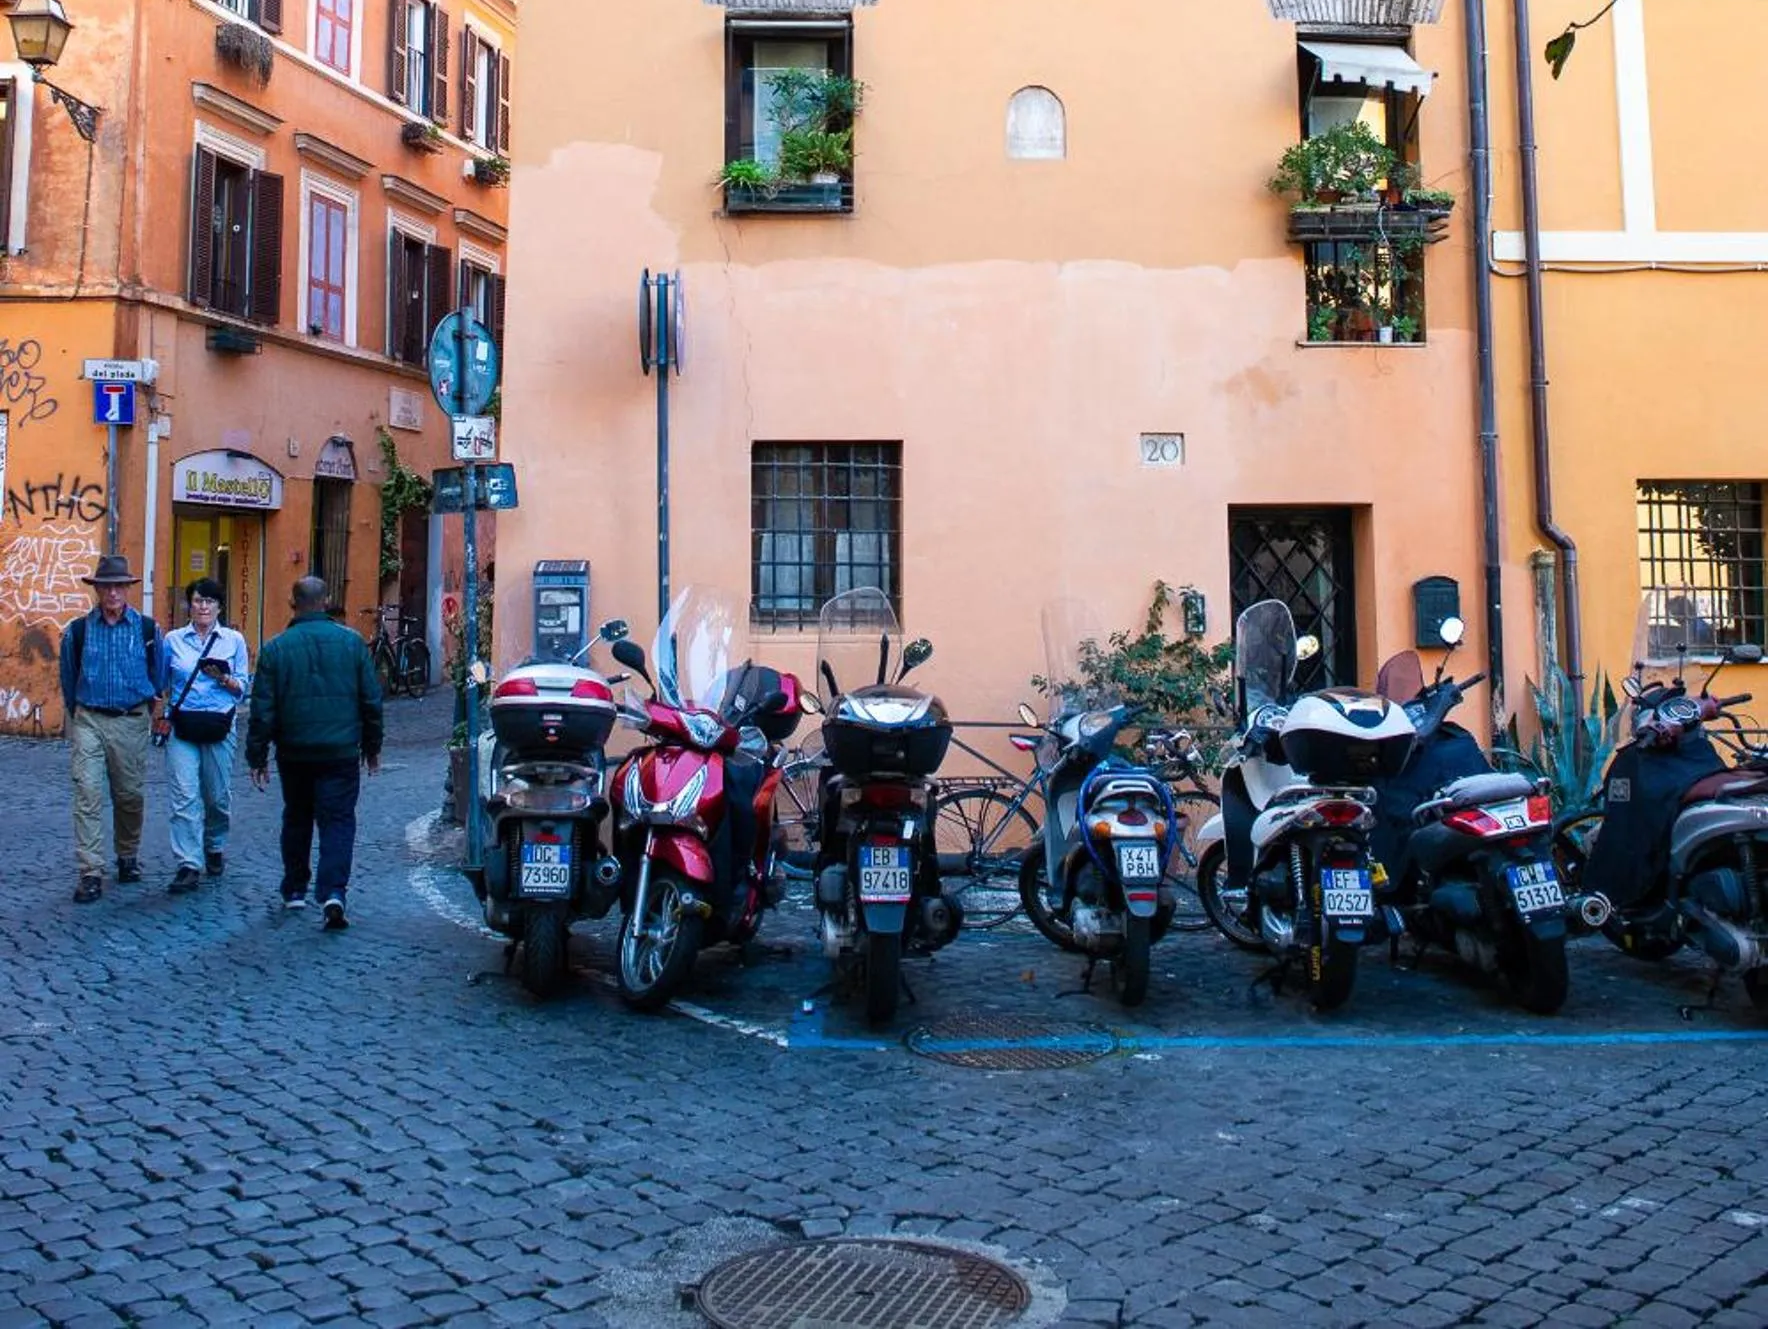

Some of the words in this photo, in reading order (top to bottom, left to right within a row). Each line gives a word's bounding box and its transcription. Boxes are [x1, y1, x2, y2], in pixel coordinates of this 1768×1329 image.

[1146, 439, 1179, 462] 20
[873, 848, 890, 866] EB
[524, 866, 568, 884] 73960
[863, 871, 908, 889] 97418
[1333, 871, 1350, 889] EF
[1326, 892, 1370, 912] 02527
[1518, 884, 1561, 909] 51312
